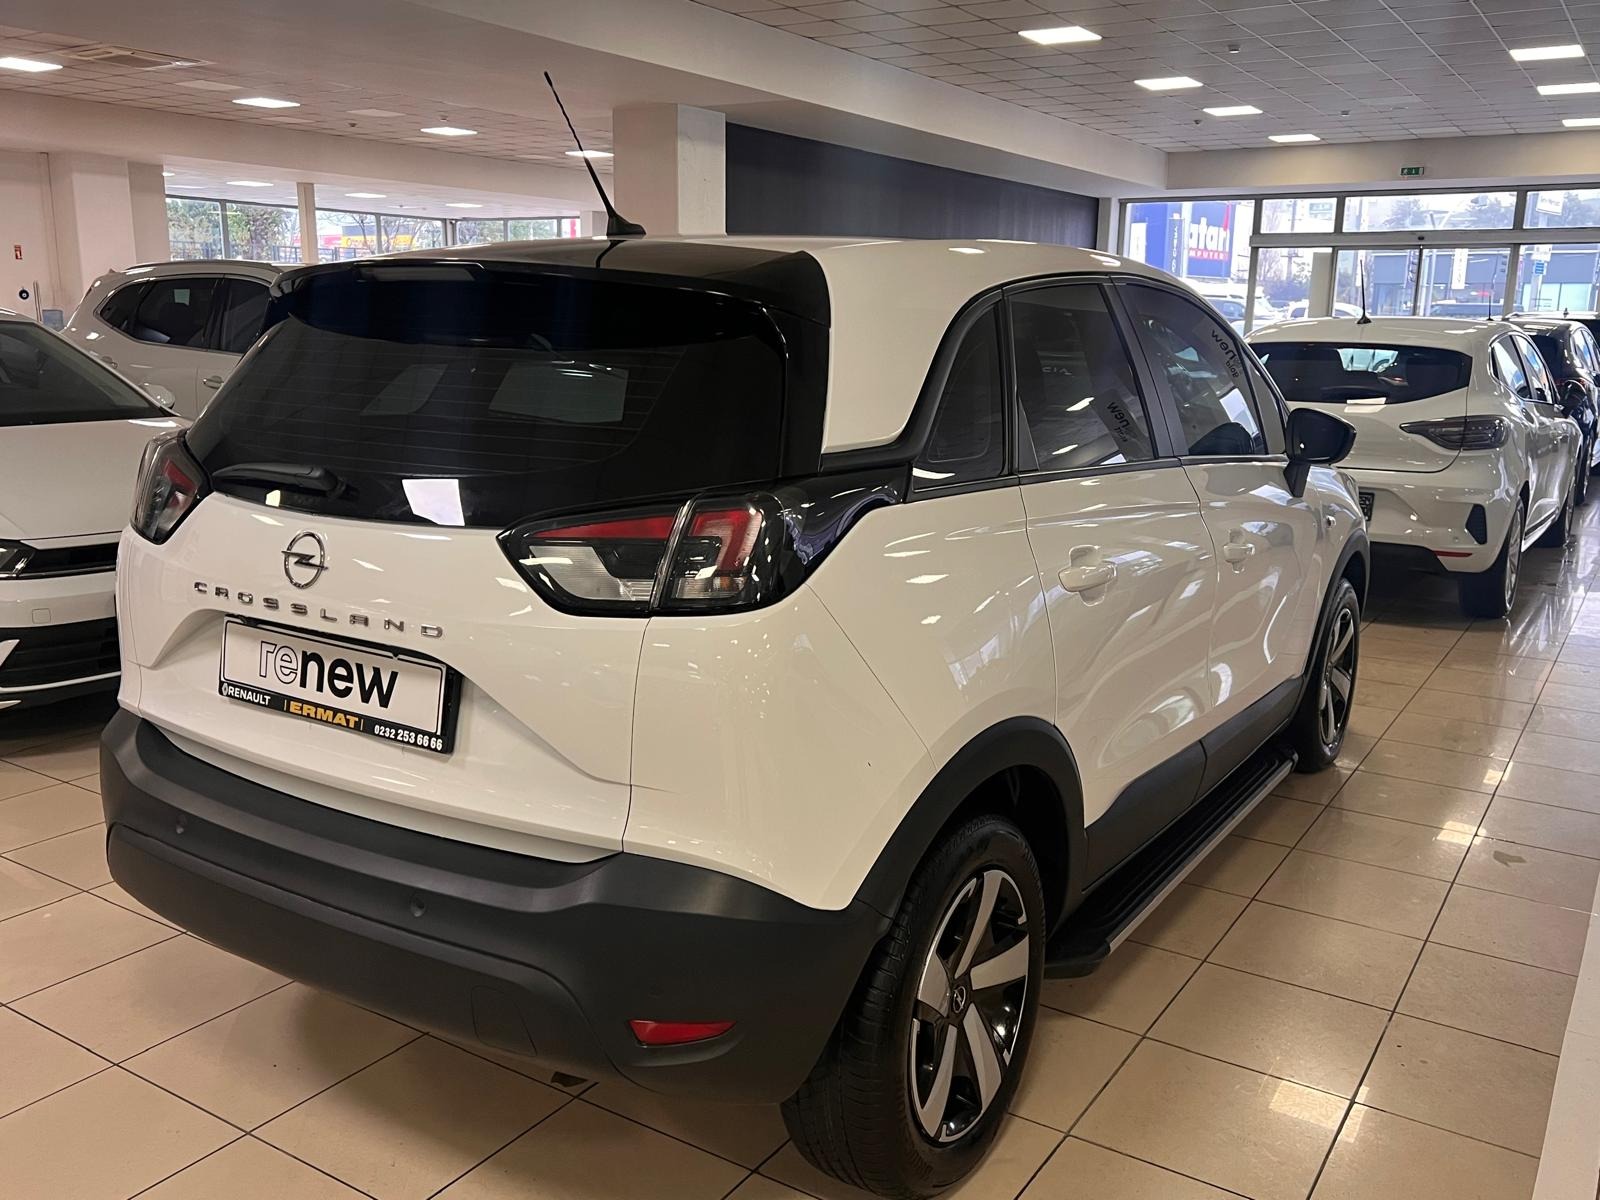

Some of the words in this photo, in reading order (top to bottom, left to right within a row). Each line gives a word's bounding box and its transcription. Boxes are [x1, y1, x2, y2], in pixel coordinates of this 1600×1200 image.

[194, 581, 443, 638] CROSSLAND
[259, 640, 399, 709] renew
[228, 686, 271, 706] RENAULT
[289, 701, 359, 729] ERMAT
[374, 724, 395, 739] 0232
[396, 729, 416, 744] 253
[416, 734, 429, 747] 66
[430, 737, 443, 751] 66
